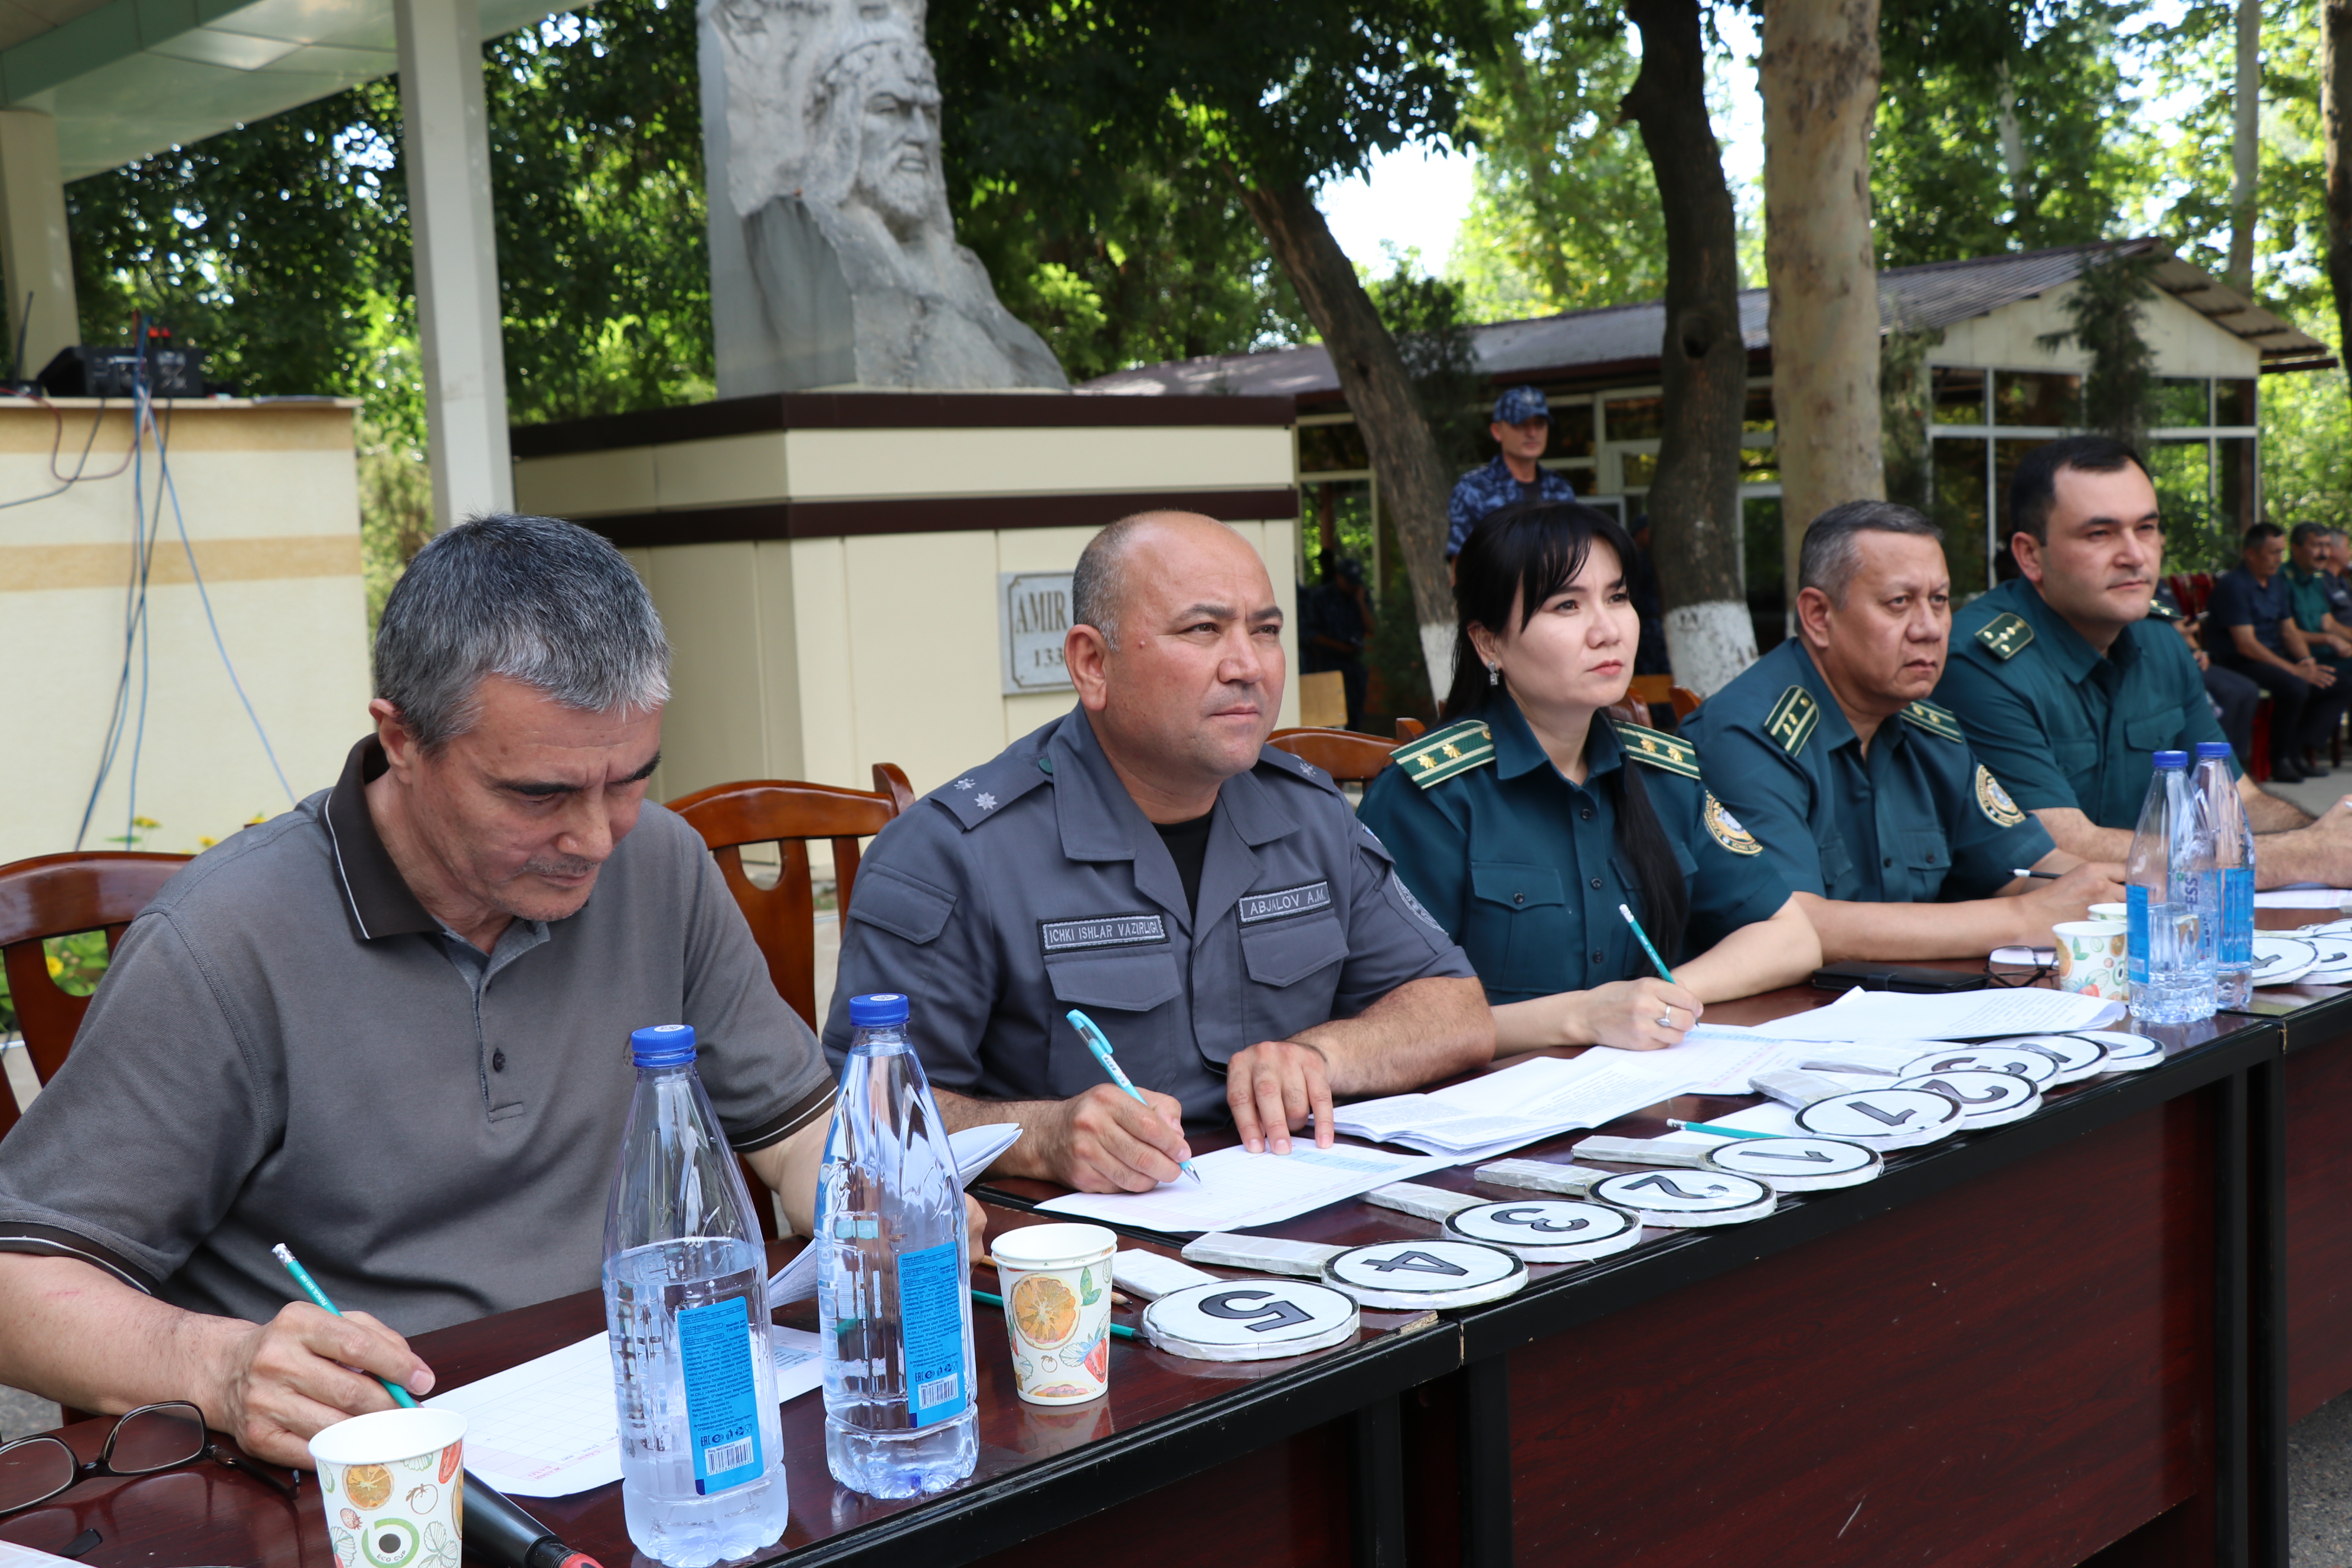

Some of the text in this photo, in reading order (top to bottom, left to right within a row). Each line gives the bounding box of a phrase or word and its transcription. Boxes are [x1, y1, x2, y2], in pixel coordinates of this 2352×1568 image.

[1015, 592, 1067, 634] AMIR
[1250, 894, 1299, 916] ABJALOV
[1049, 921, 1159, 943] ICHKI ISHLAR VAZIRLIGI
[1621, 1174, 1730, 1200] 2
[1490, 1208, 1590, 1233] 3
[1361, 1250, 1469, 1277] 4
[1198, 1290, 1314, 1332] 5
[915, 1371, 924, 1382] EAC
[701, 1435, 711, 1446] EAC
[377, 1550, 406, 1562] ECO CUP
